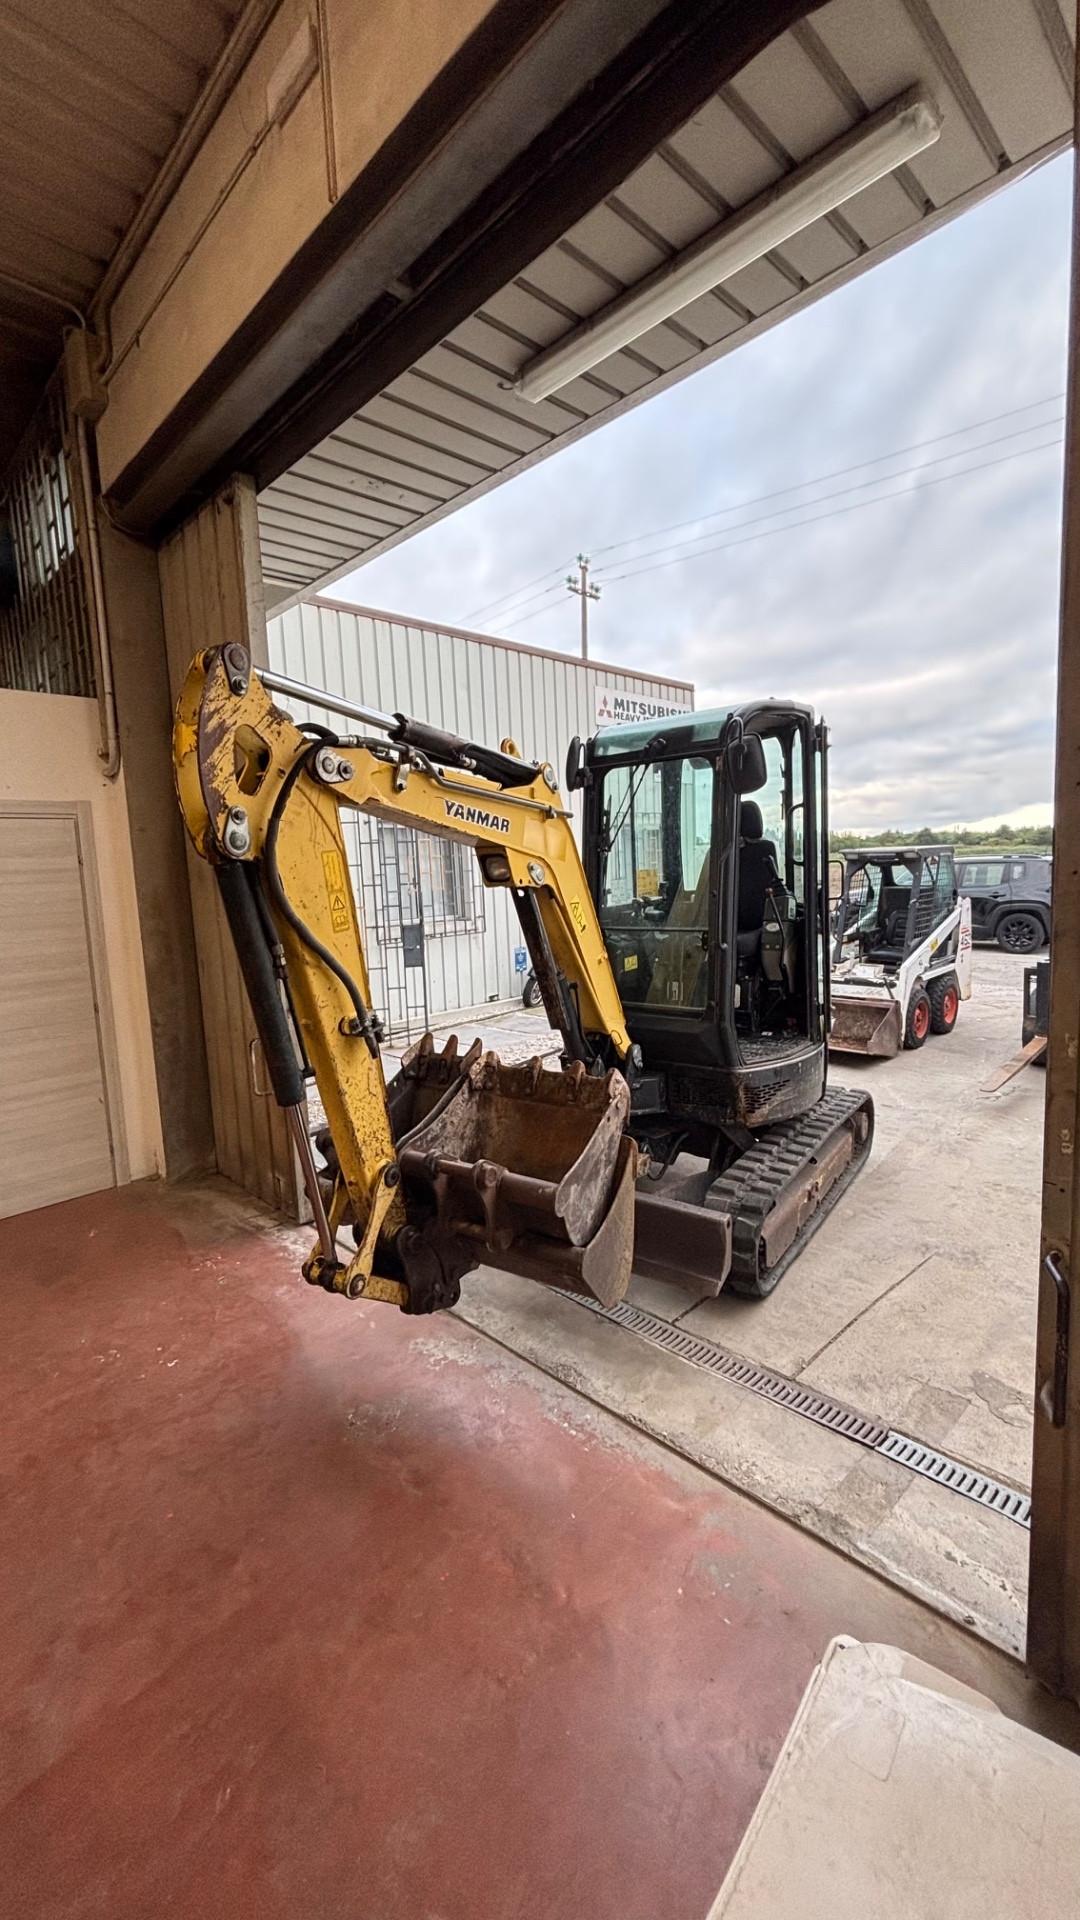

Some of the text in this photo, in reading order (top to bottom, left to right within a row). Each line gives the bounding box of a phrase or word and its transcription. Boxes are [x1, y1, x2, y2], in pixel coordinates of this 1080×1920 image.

[614, 697, 690, 717] MITSUBIS
[614, 711, 640, 722] HEAVY
[444, 800, 510, 832] YANMAR
